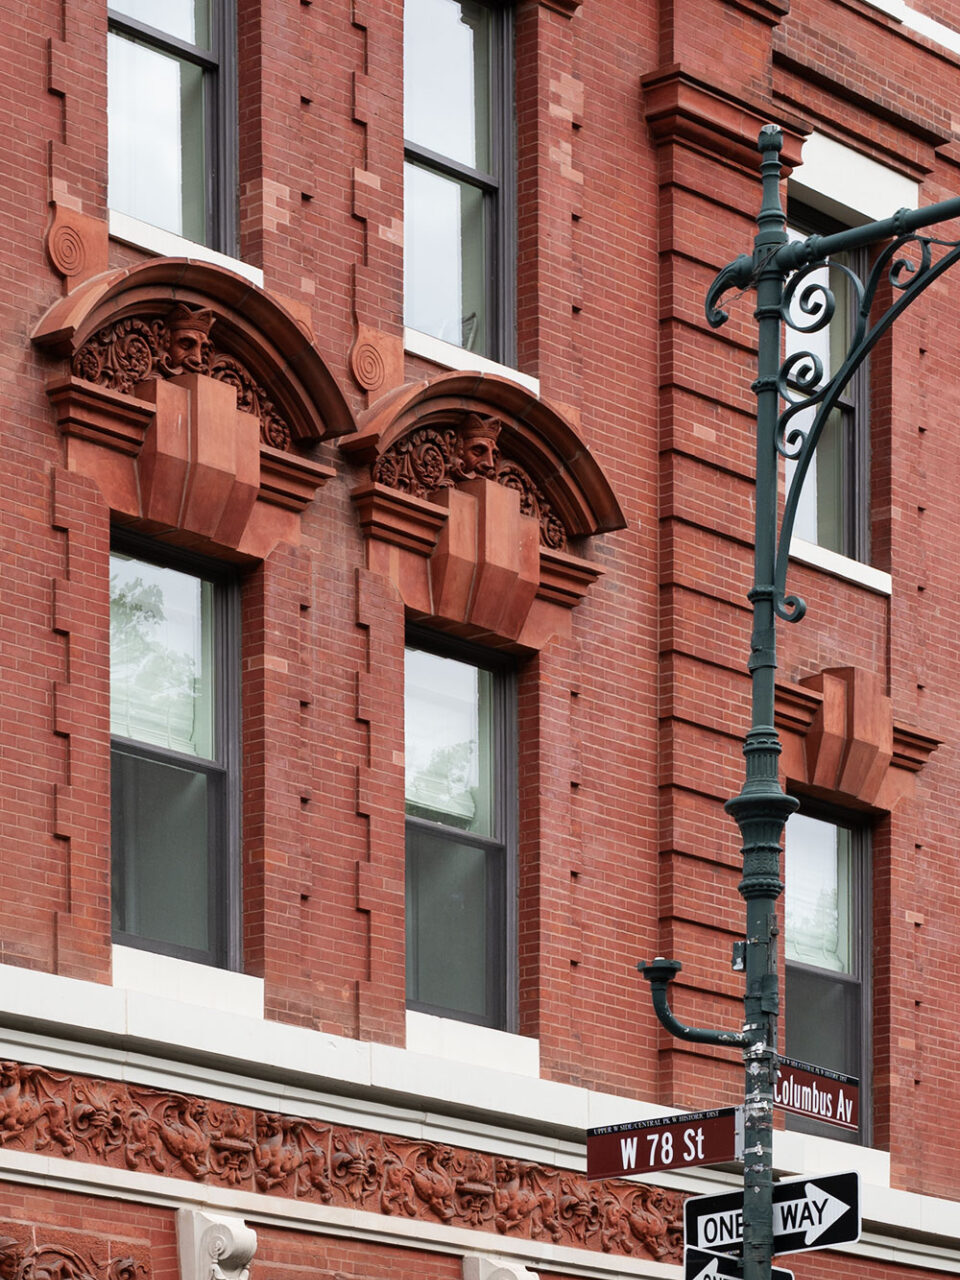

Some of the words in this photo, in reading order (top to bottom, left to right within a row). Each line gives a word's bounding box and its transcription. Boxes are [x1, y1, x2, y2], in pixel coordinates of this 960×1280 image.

[773, 1069, 832, 1117] Columbus
[836, 1088, 853, 1122] Av
[593, 1125, 613, 1135] UPPER
[613, 1123, 619, 1132] W
[672, 1115, 678, 1123] W
[620, 1137, 638, 1170] W
[646, 1132, 673, 1166] 78
[683, 1127, 705, 1161] St
[703, 1212, 743, 1243] ONE
[781, 1198, 829, 1231] WAY
